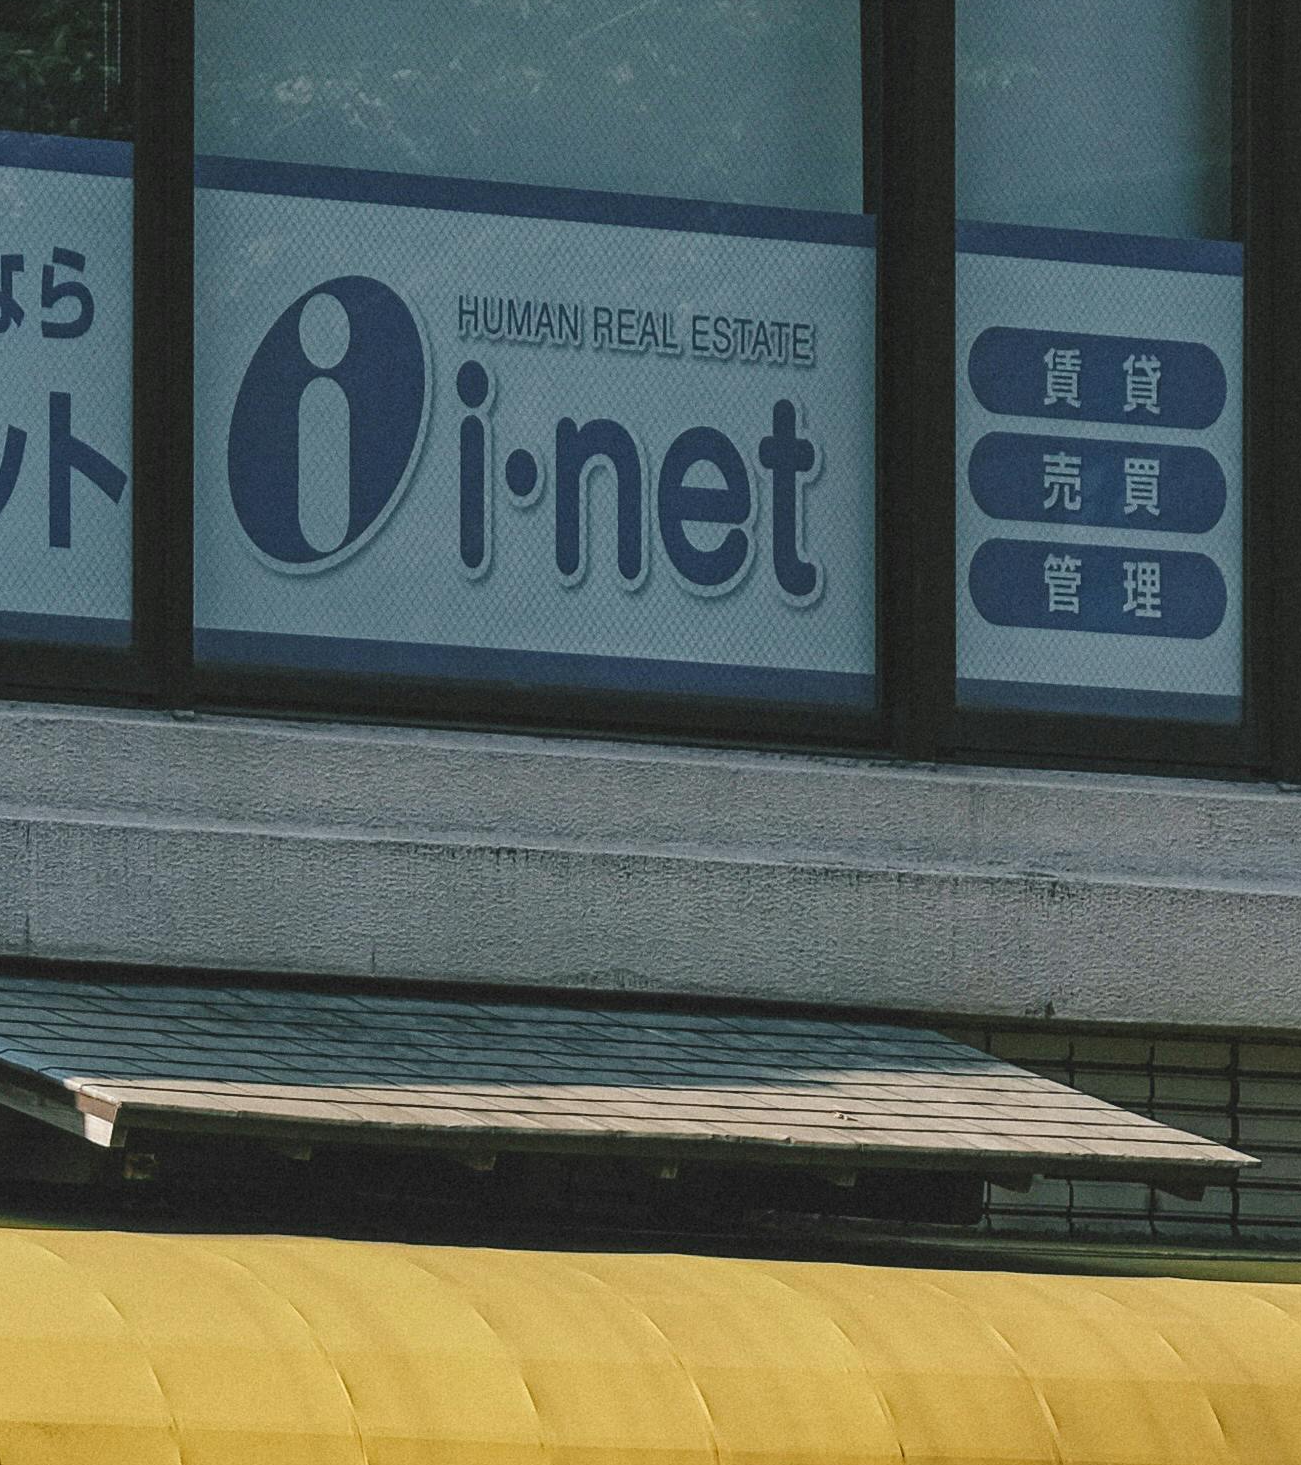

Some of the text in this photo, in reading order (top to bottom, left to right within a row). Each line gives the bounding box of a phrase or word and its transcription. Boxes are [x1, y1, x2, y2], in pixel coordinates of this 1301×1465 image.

[457, 294, 815, 362] HUMAN REAL ESTATE
[1042, 347, 1163, 416] 賃貸
[1042, 451, 1163, 518] 売買
[1042, 552, 1163, 620] 管理
